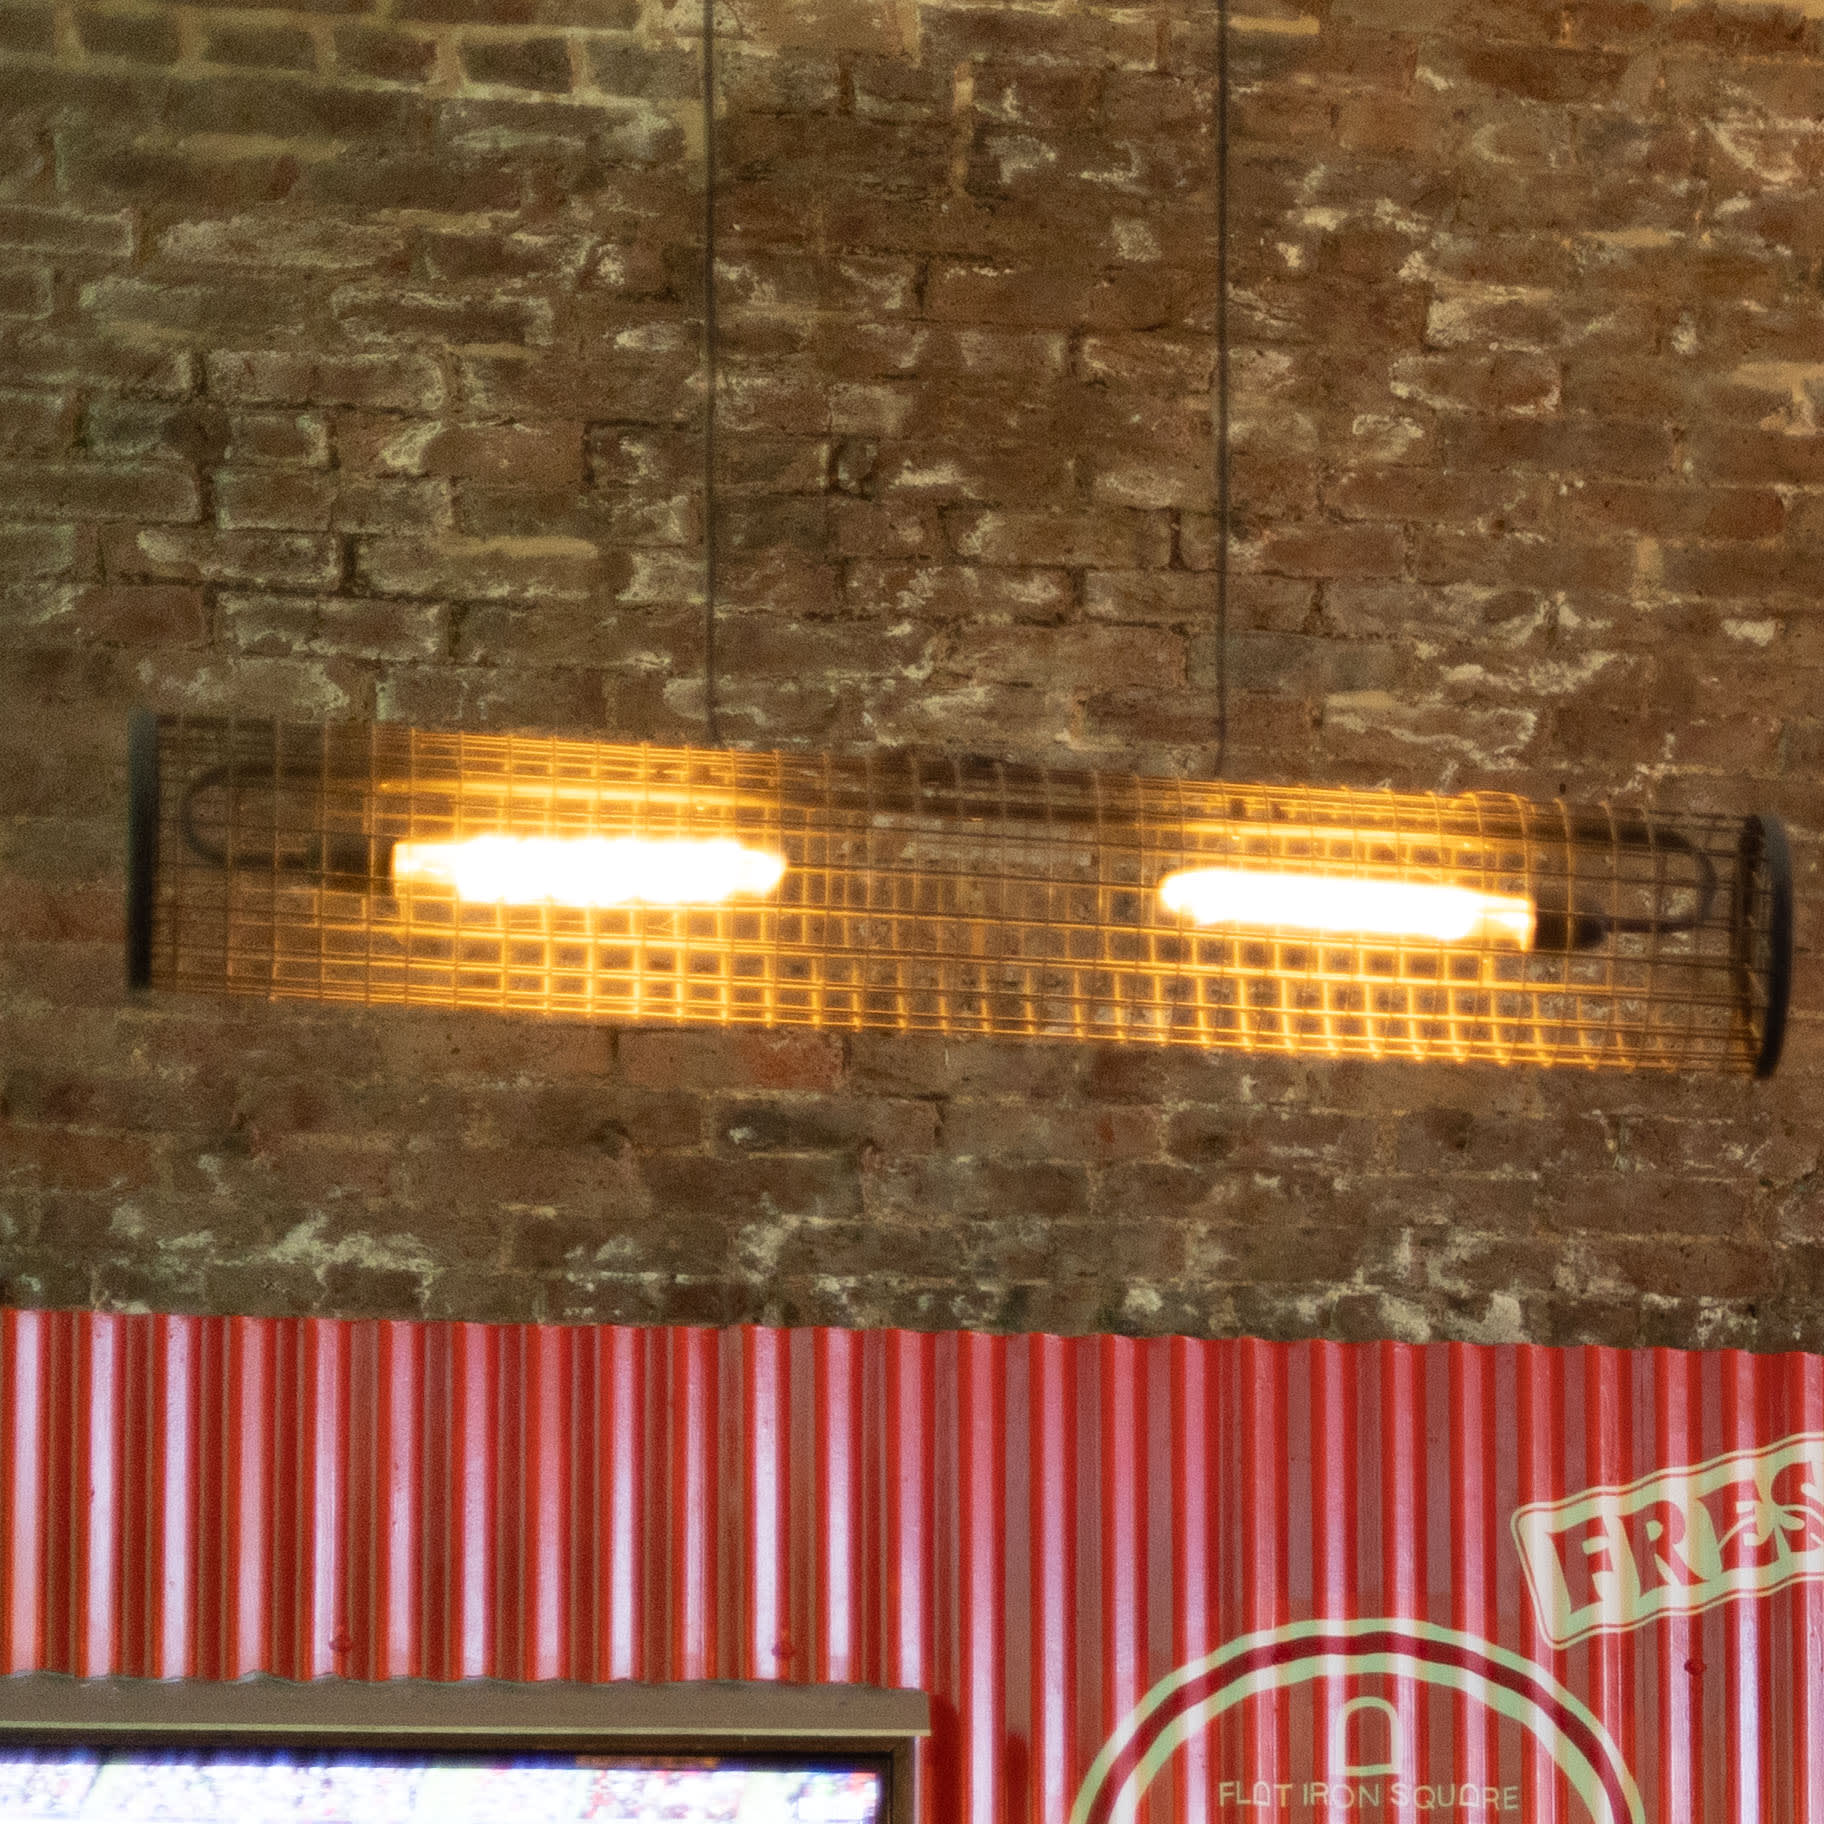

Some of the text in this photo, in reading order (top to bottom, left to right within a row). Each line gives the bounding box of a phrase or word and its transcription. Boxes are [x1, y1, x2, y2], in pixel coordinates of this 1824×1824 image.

[1218, 1781, 1520, 1811] FLAT IRON SQUARE
